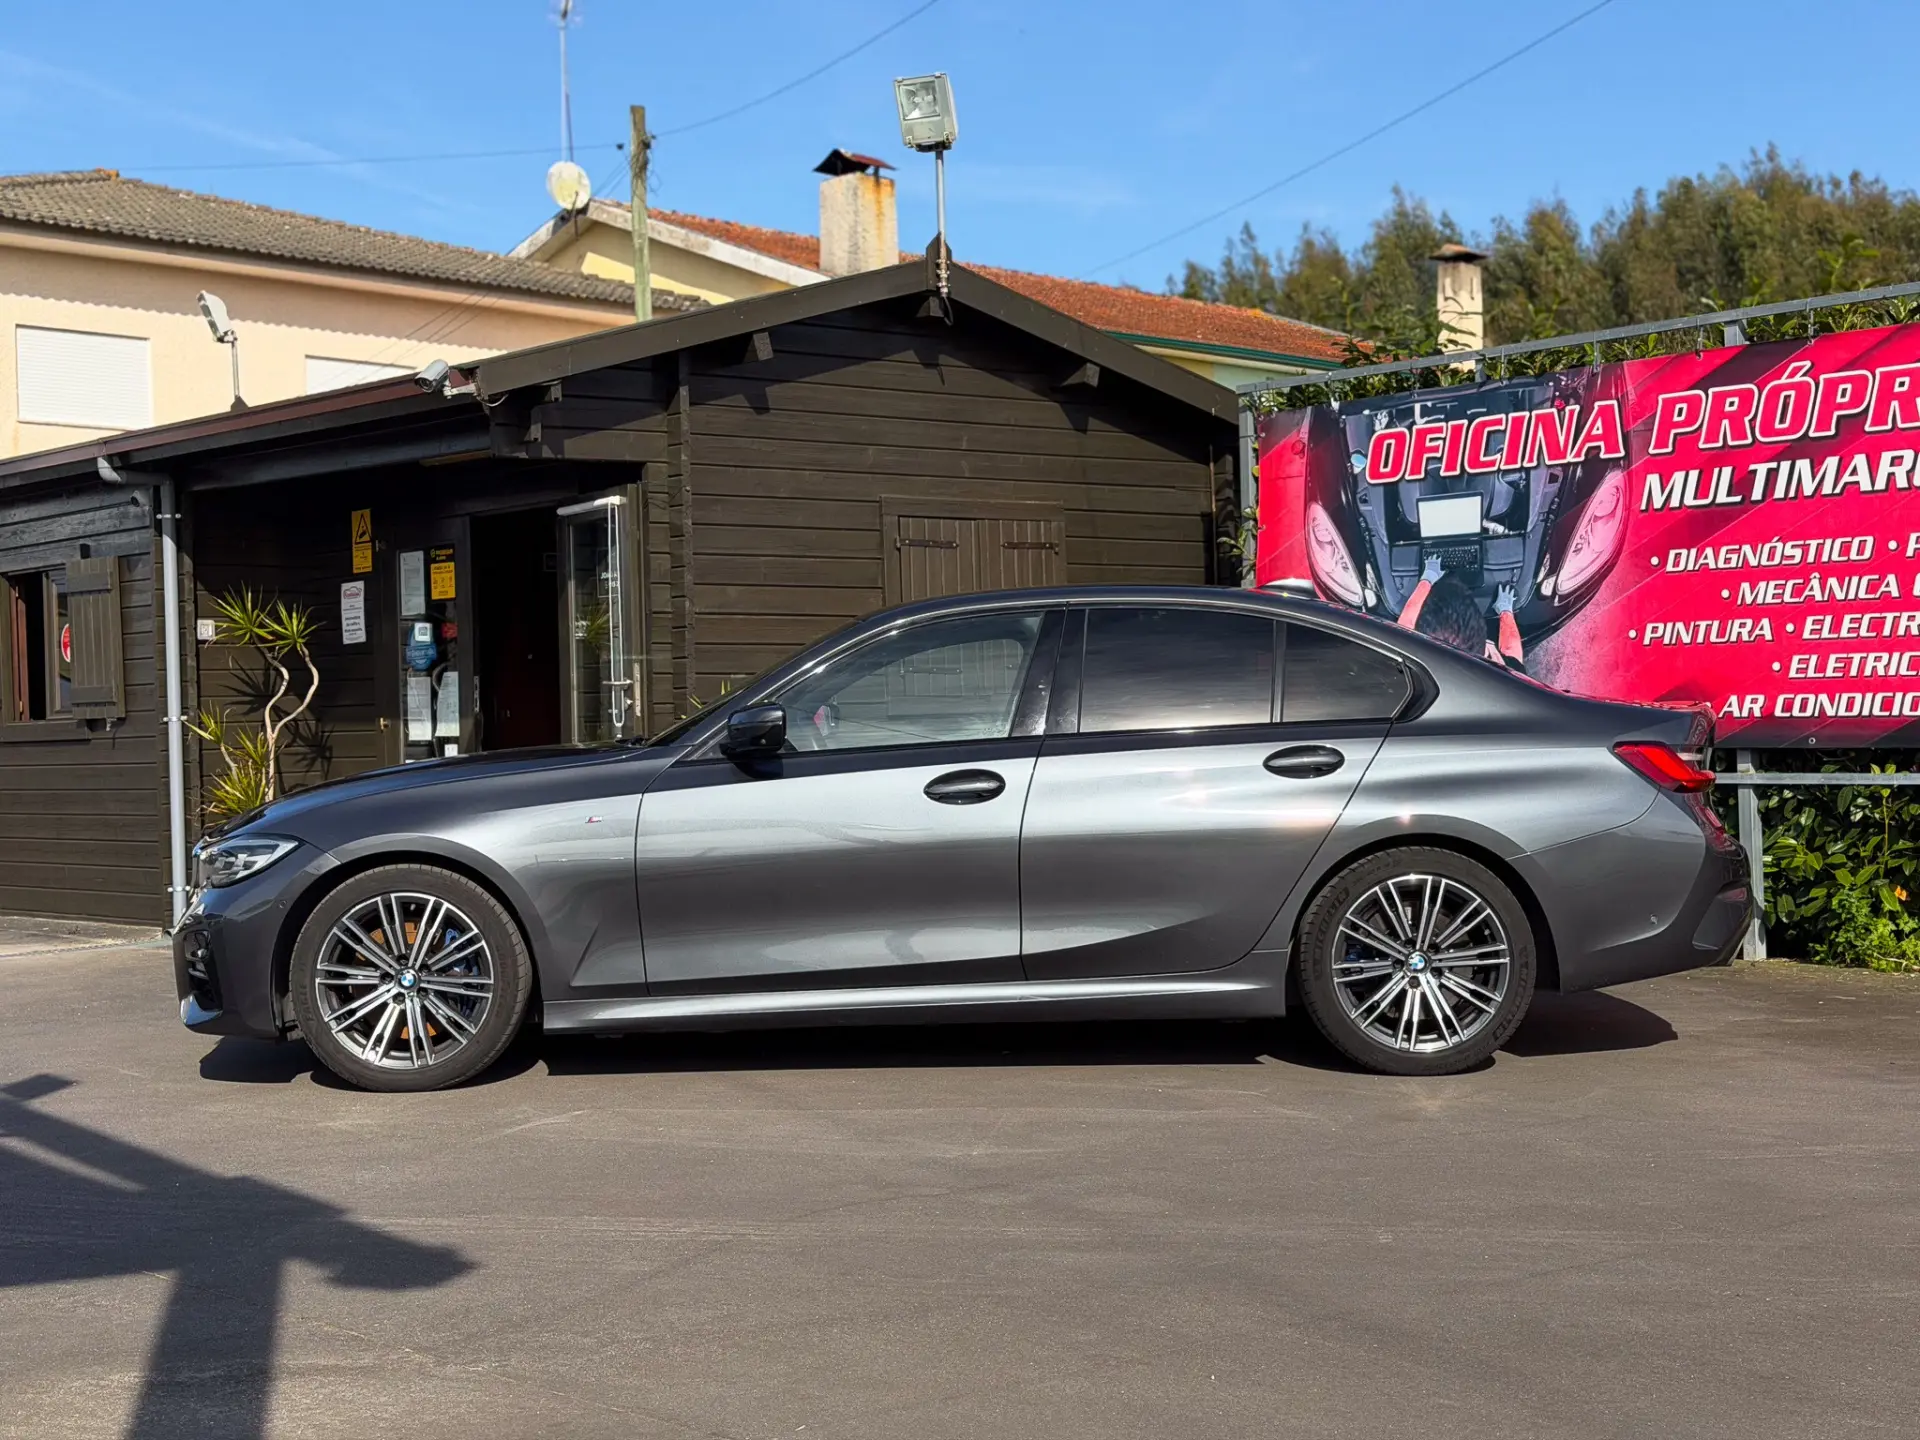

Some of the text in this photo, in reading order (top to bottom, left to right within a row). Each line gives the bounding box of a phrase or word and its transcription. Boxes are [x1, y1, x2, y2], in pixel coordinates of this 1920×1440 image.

[1366, 360, 1920, 484] OFICINA PRÓPR
[1666, 535, 1874, 573] DIAGNÓSTICO
[1737, 573, 1900, 605] MECÂNICA
[1643, 611, 1920, 645] PINTURA ELECTR
[1719, 694, 1764, 717] AR
